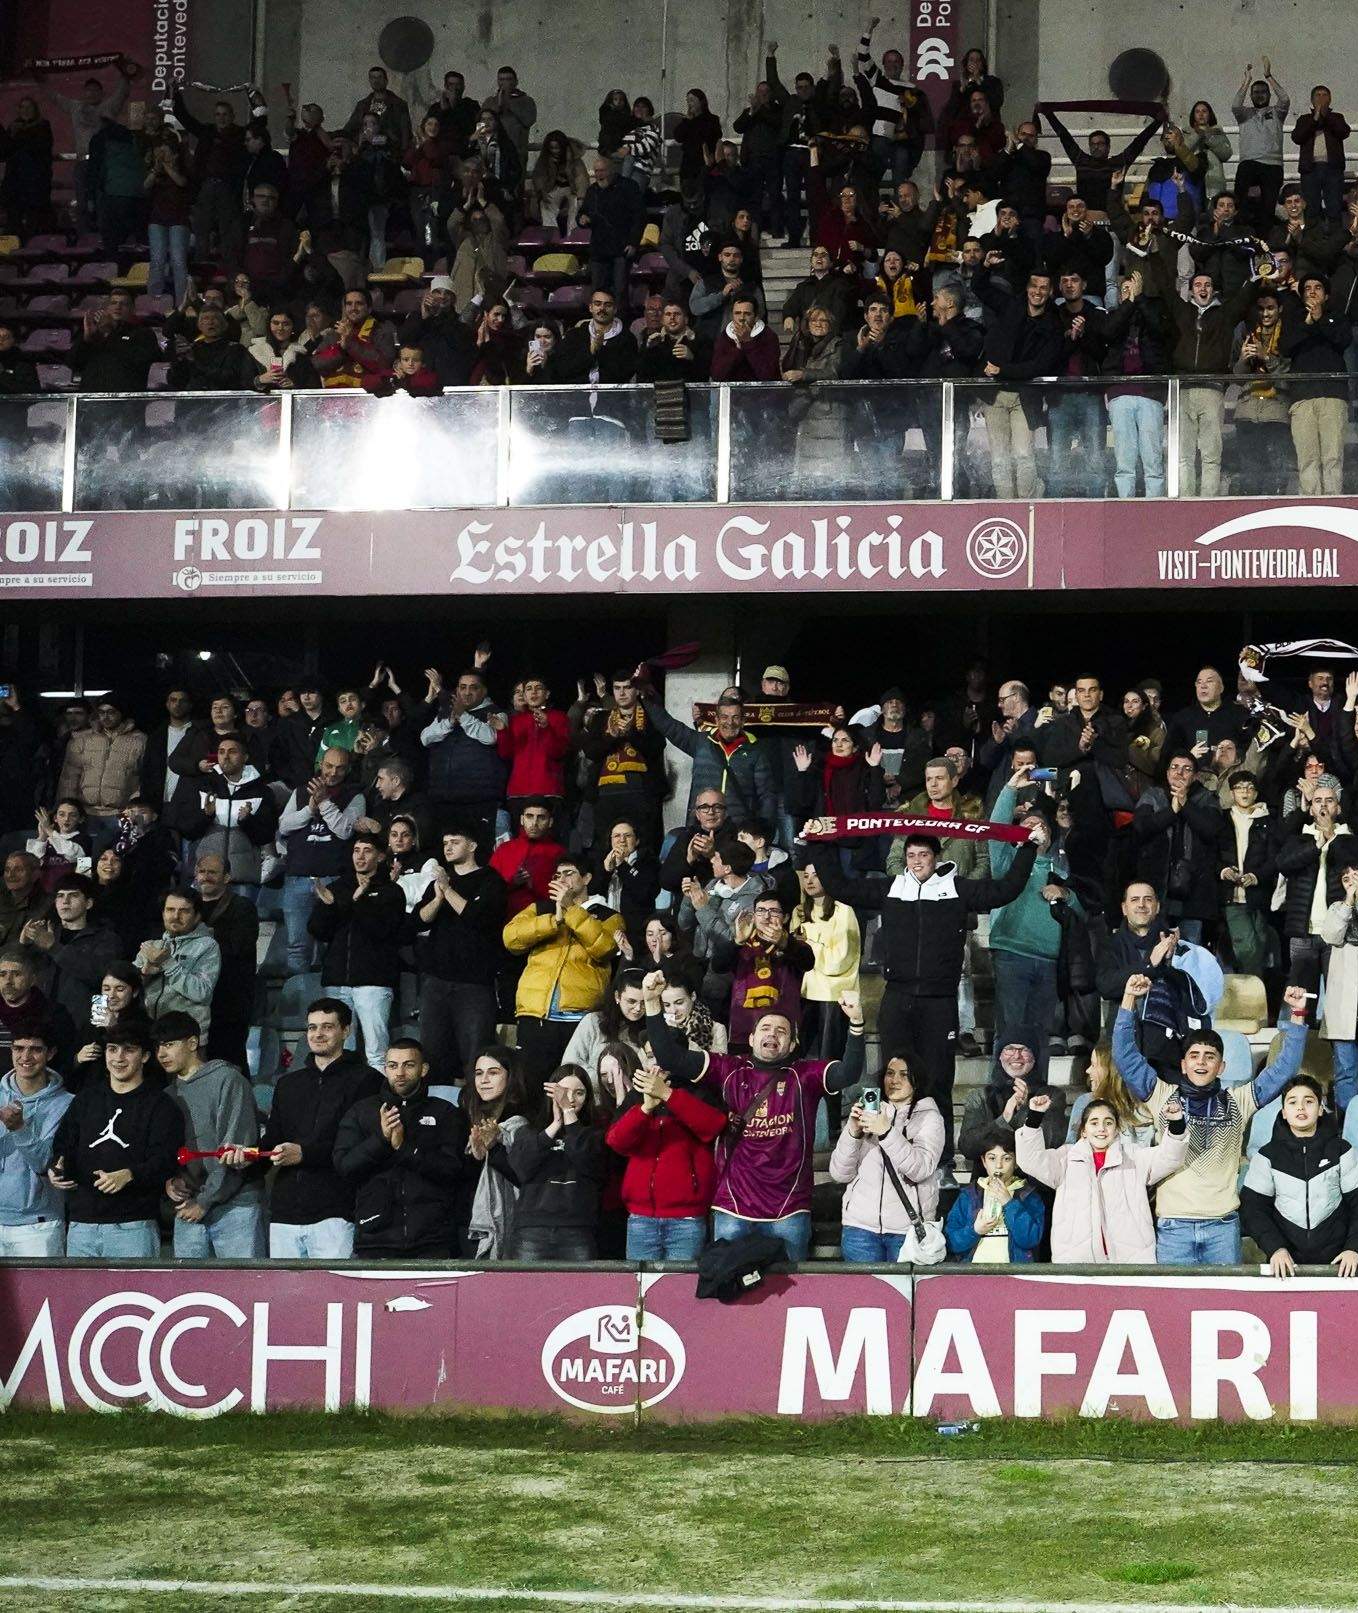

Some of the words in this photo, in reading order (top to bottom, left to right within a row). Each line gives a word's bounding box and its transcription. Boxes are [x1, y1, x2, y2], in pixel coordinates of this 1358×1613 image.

[172, 0, 187, 91] onteved
[173, 518, 324, 561] FROIZ
[449, 520, 701, 583] Estrella
[715, 515, 947, 581] Galicia
[48, 575, 87, 584] servicio
[208, 573, 250, 584] Siempre
[262, 574, 273, 582] su
[278, 573, 316, 582] servicio
[1158, 548, 1340, 580] VISIT-PONTEVEDRA.GAL
[559, 1358, 667, 1384] MAFARI
[777, 1306, 1318, 1421] MAFARI
[601, 1384, 624, 1395] CAFÉ
